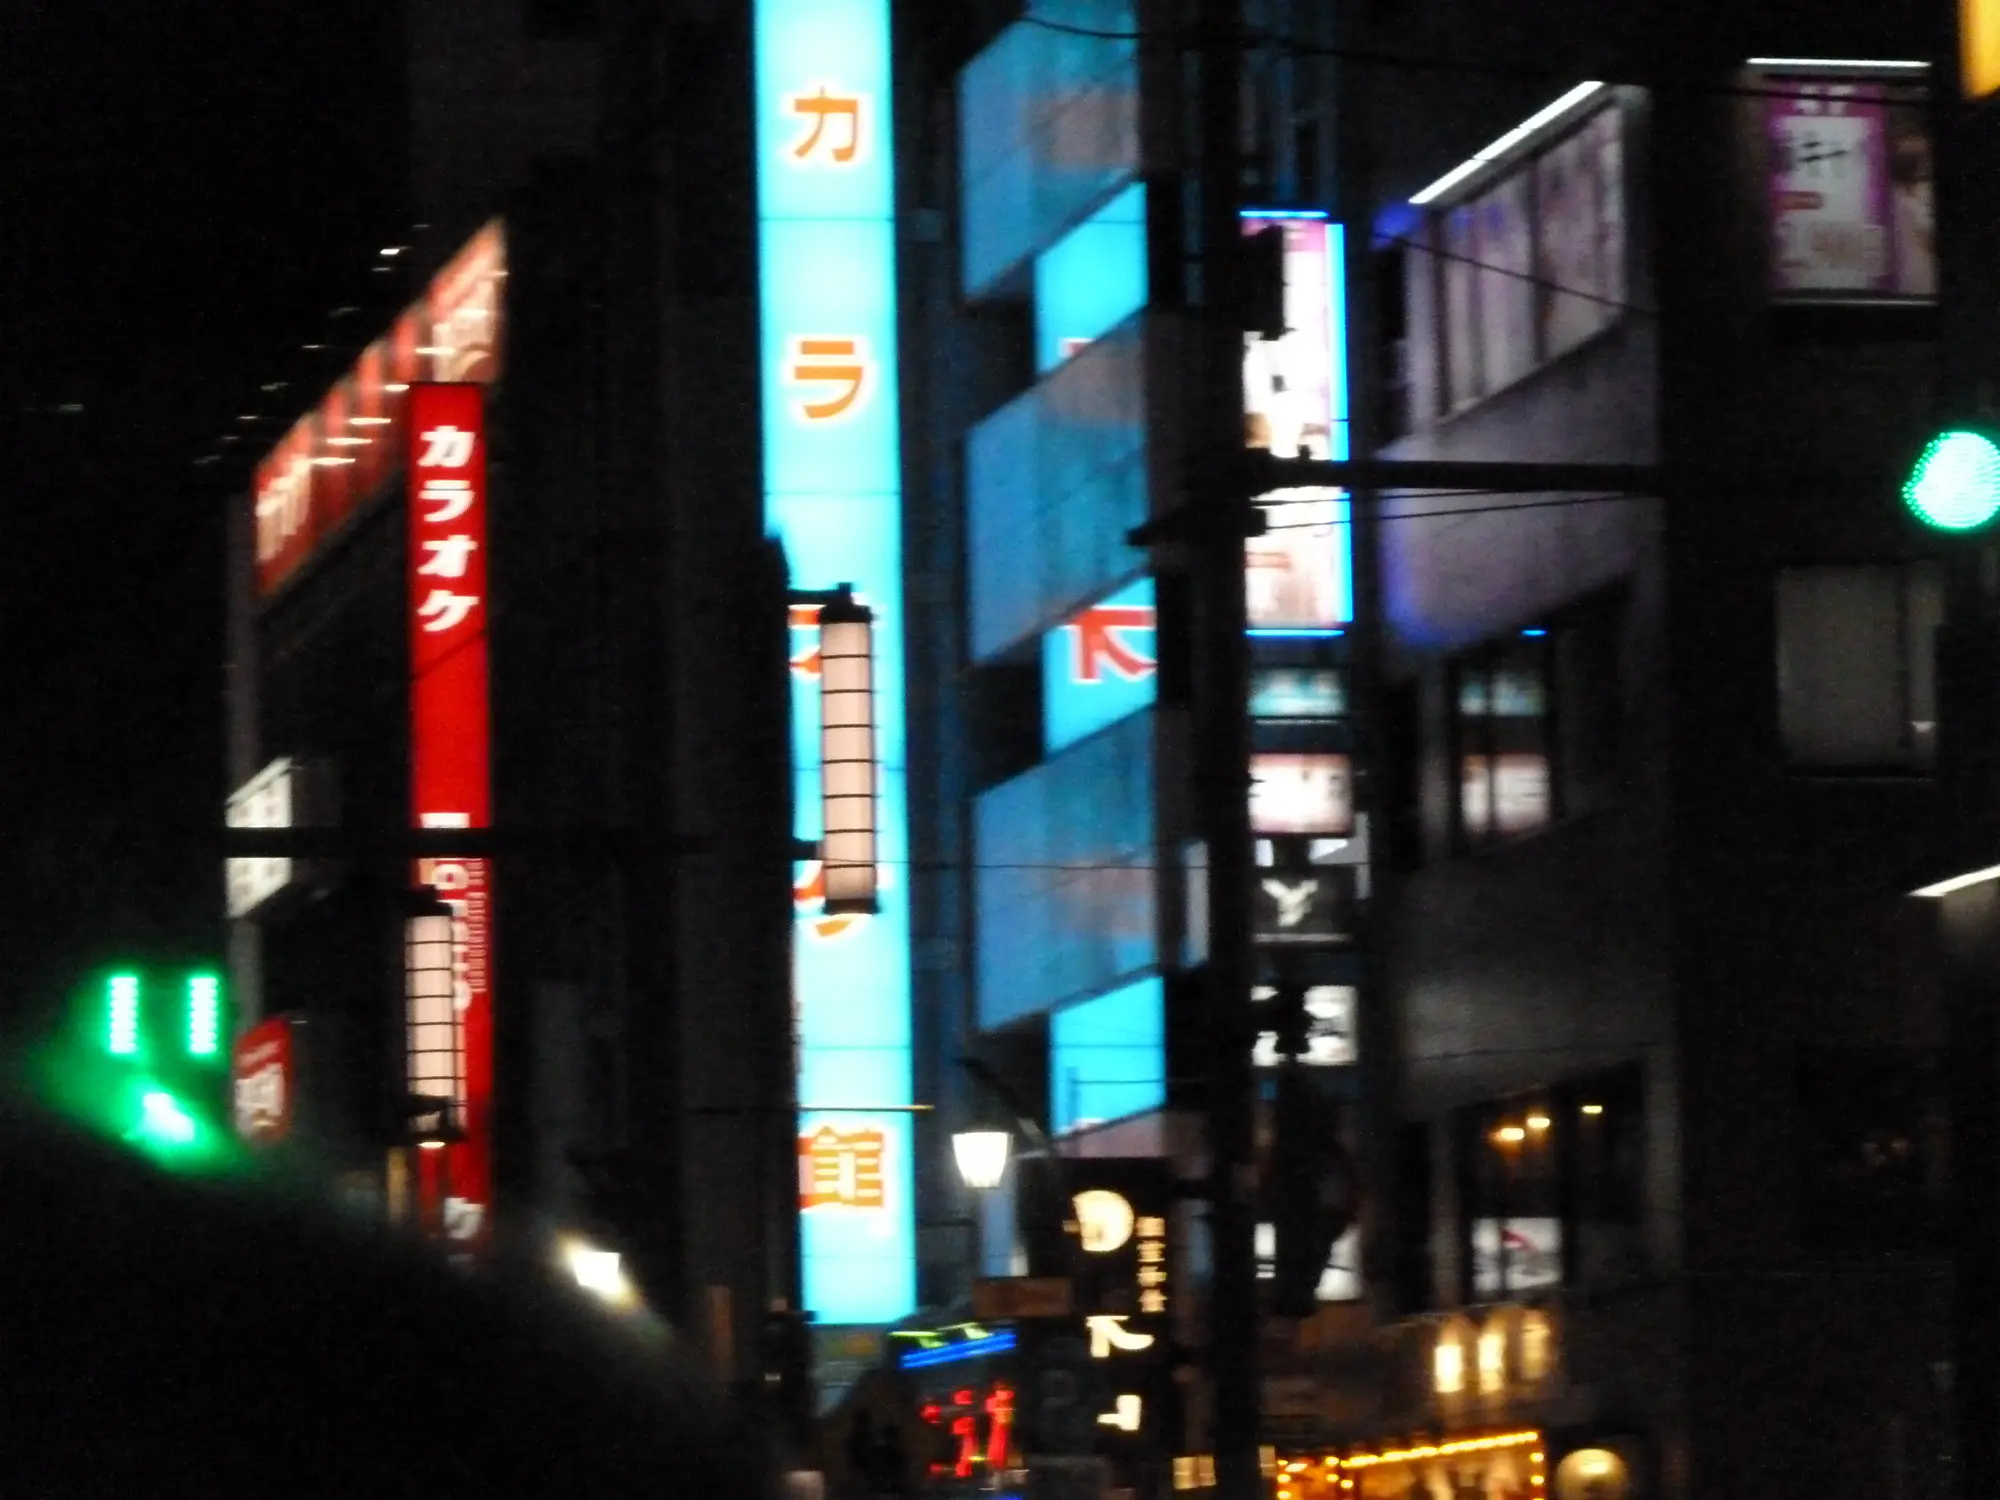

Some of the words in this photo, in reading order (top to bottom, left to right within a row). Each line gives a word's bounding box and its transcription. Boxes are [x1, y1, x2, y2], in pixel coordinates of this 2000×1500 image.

[417, 426, 480, 632] カラオケ
[788, 87, 884, 1208] カラ館
